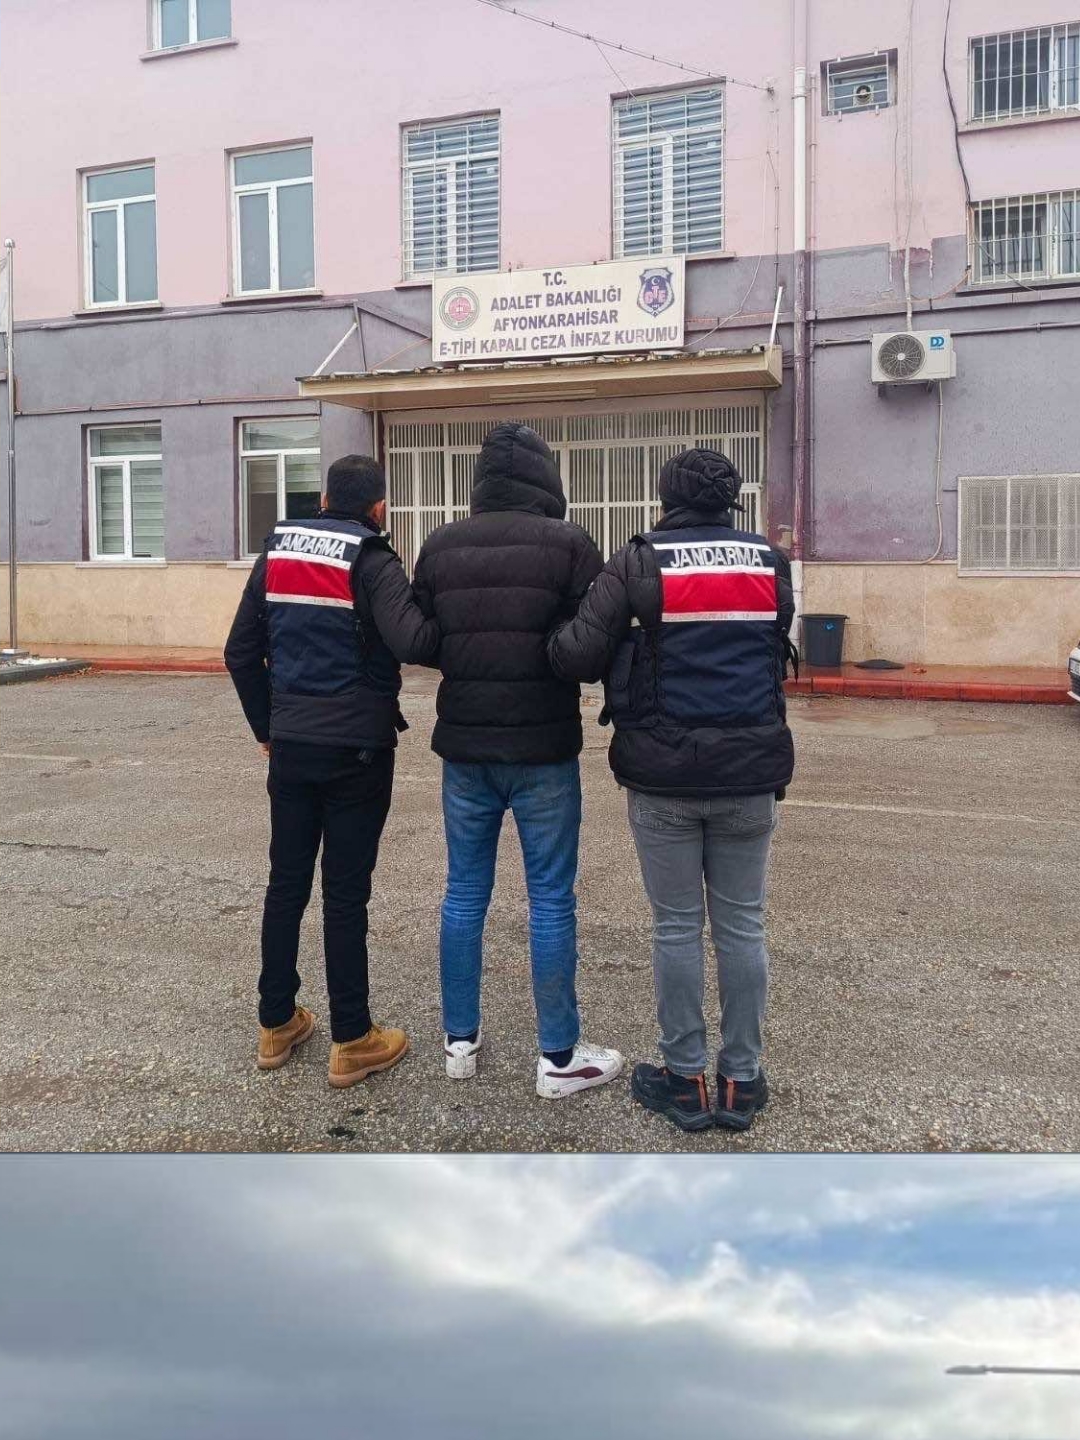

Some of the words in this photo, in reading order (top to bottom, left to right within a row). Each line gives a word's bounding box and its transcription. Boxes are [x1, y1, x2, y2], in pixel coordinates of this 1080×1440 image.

[543, 271, 567, 286] T.C.
[490, 294, 542, 312] ADALET
[546, 285, 622, 307] BAKANLIĞI
[493, 308, 619, 332] AFYONKARAHİSAR
[440, 338, 476, 356] E-TİPİ
[480, 337, 527, 354] KAPALI
[530, 334, 567, 350] CEZA
[570, 330, 611, 347] İNFAZ
[615, 326, 678, 345] KURUMU
[275, 533, 347, 559] JANDARMA
[670, 546, 764, 568] JANDARMA
